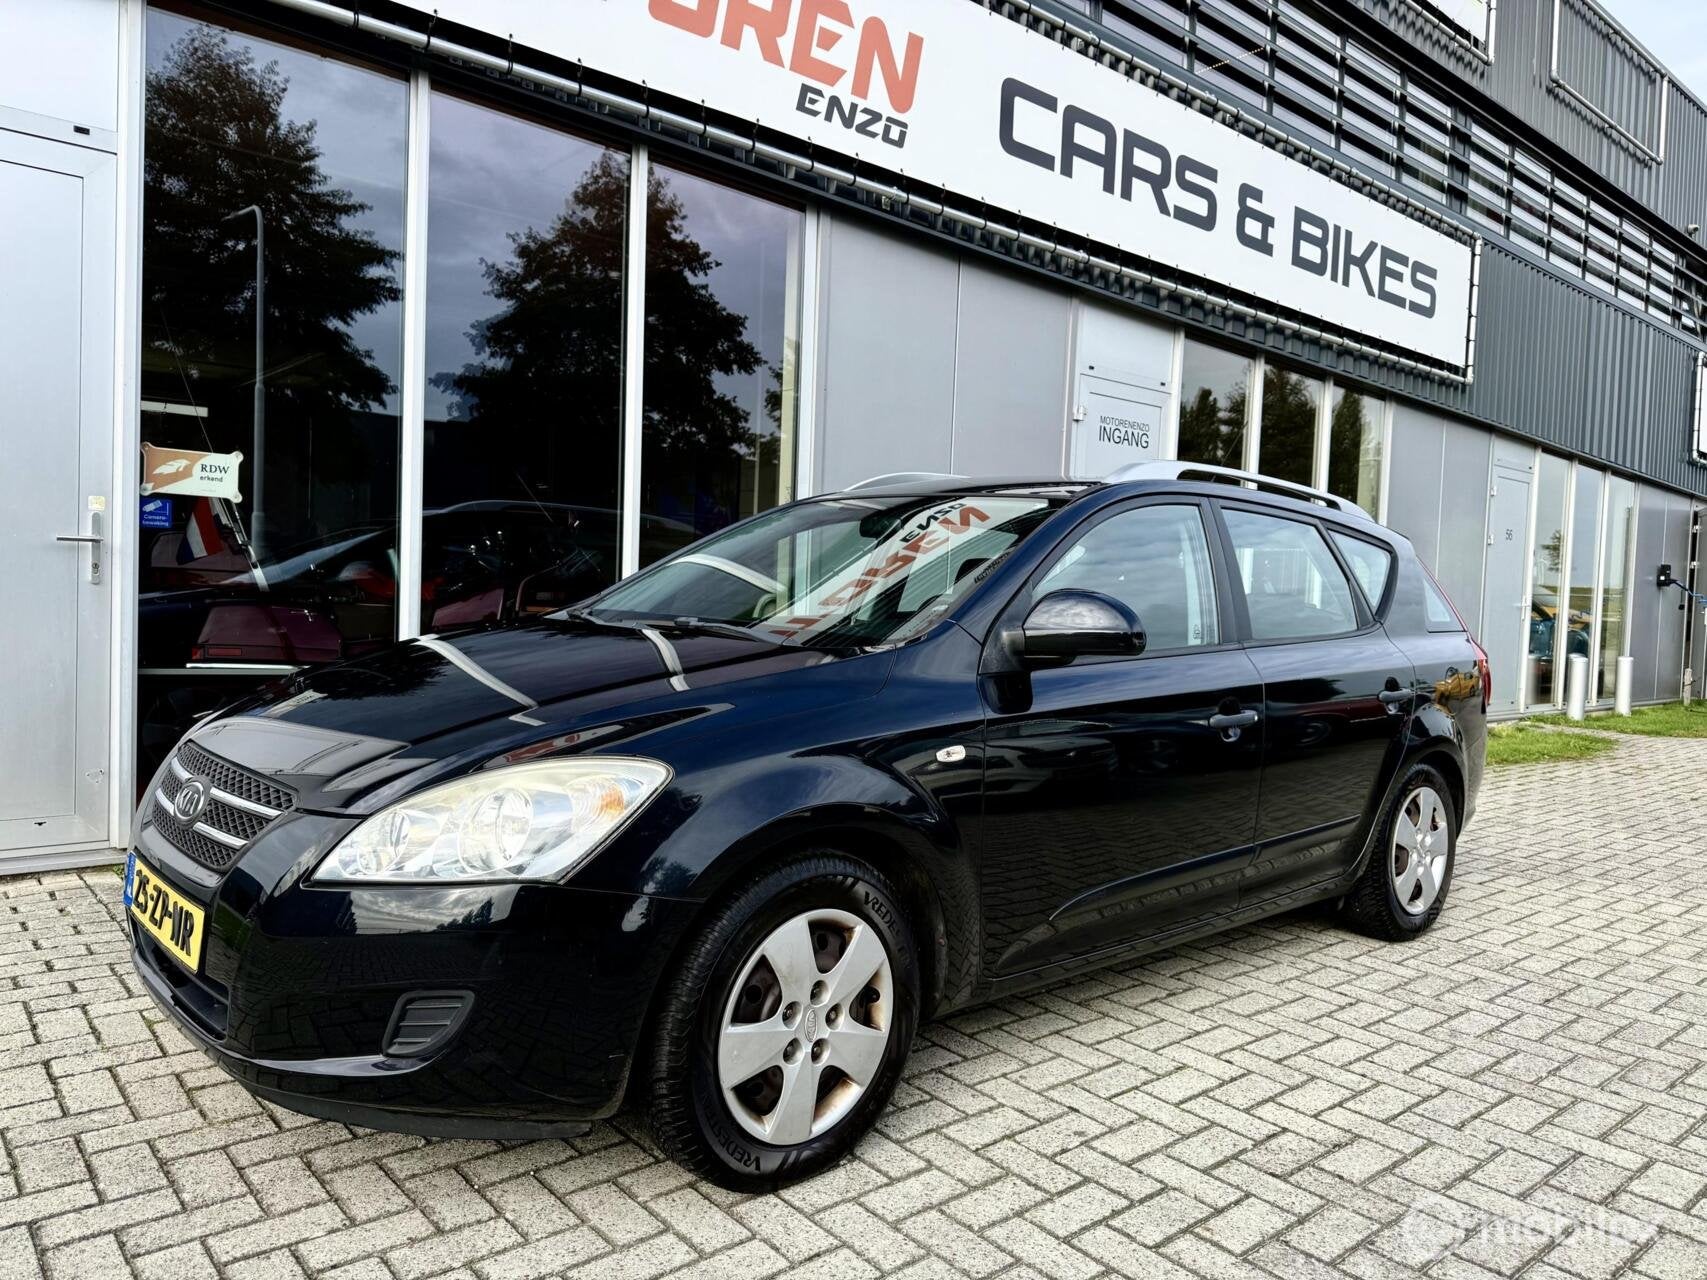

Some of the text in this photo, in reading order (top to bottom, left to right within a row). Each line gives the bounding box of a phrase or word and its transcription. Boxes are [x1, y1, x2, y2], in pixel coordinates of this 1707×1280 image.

[796, 83, 909, 149] ENZO
[999, 77, 1437, 319] CARS & BIKES
[1100, 415, 1150, 432] MOTORENENZO
[1099, 425, 1149, 449] INGANG
[200, 463, 230, 475] RDW
[1505, 528, 1513, 541] 56
